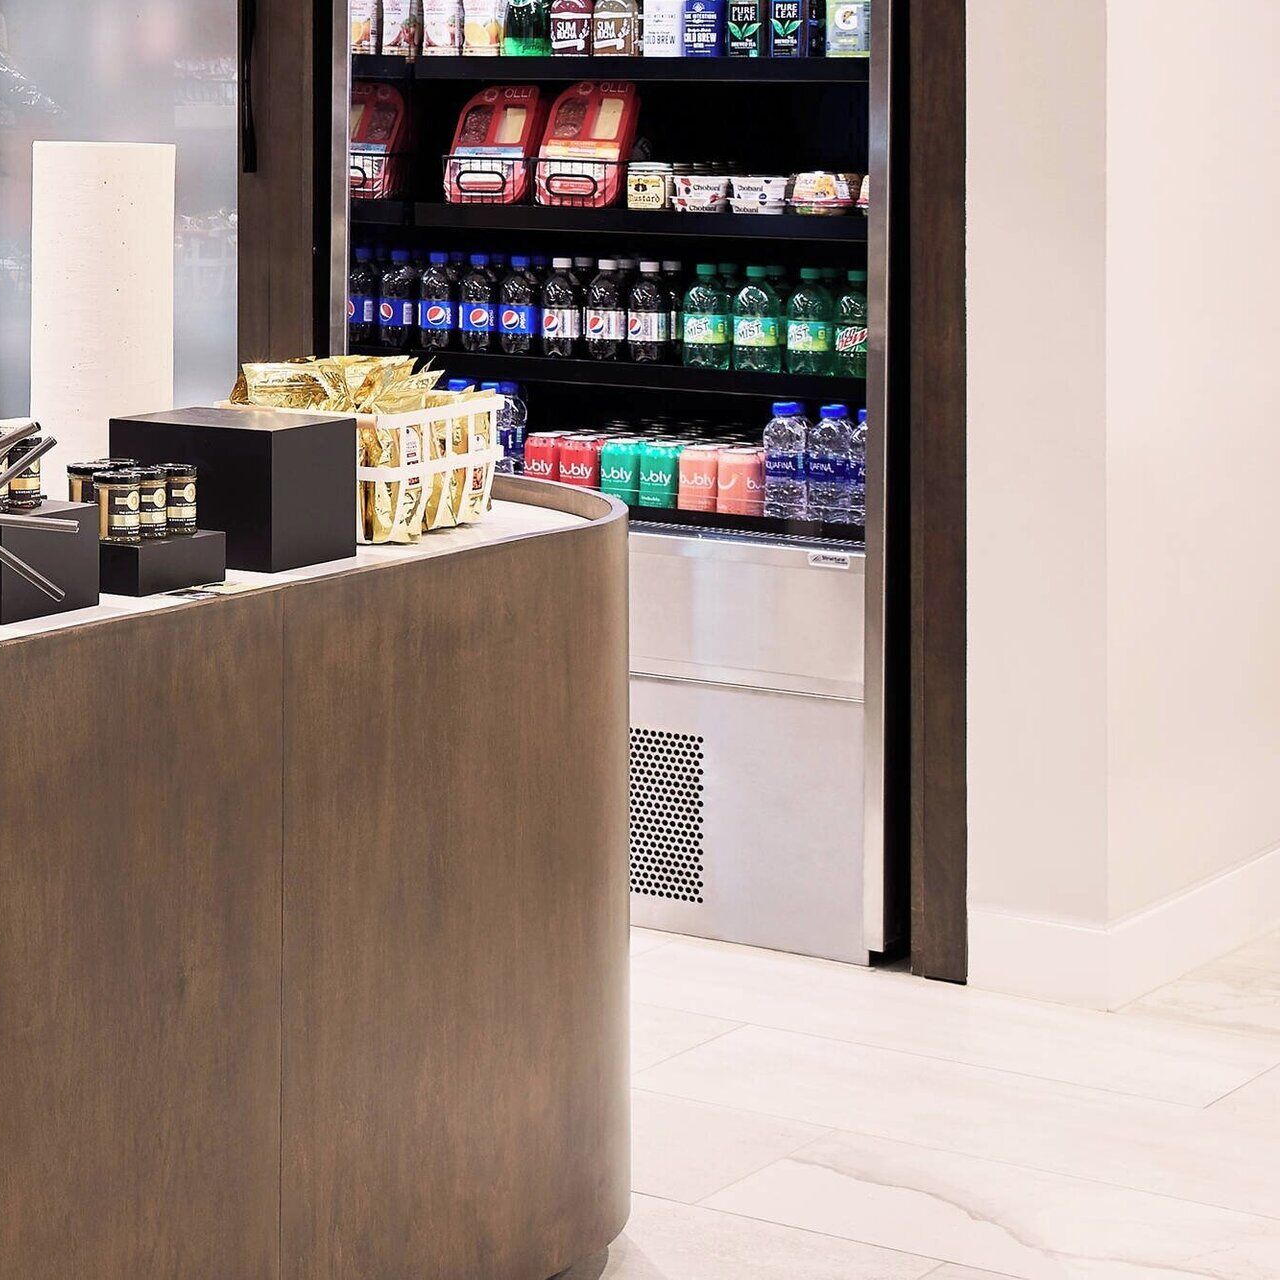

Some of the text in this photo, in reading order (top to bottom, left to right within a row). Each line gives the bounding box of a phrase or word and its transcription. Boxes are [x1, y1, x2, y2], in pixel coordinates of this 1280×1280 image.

[732, 6, 756, 14] PURE
[600, 82, 629, 93] OLLI
[504, 88, 532, 98] OLLI
